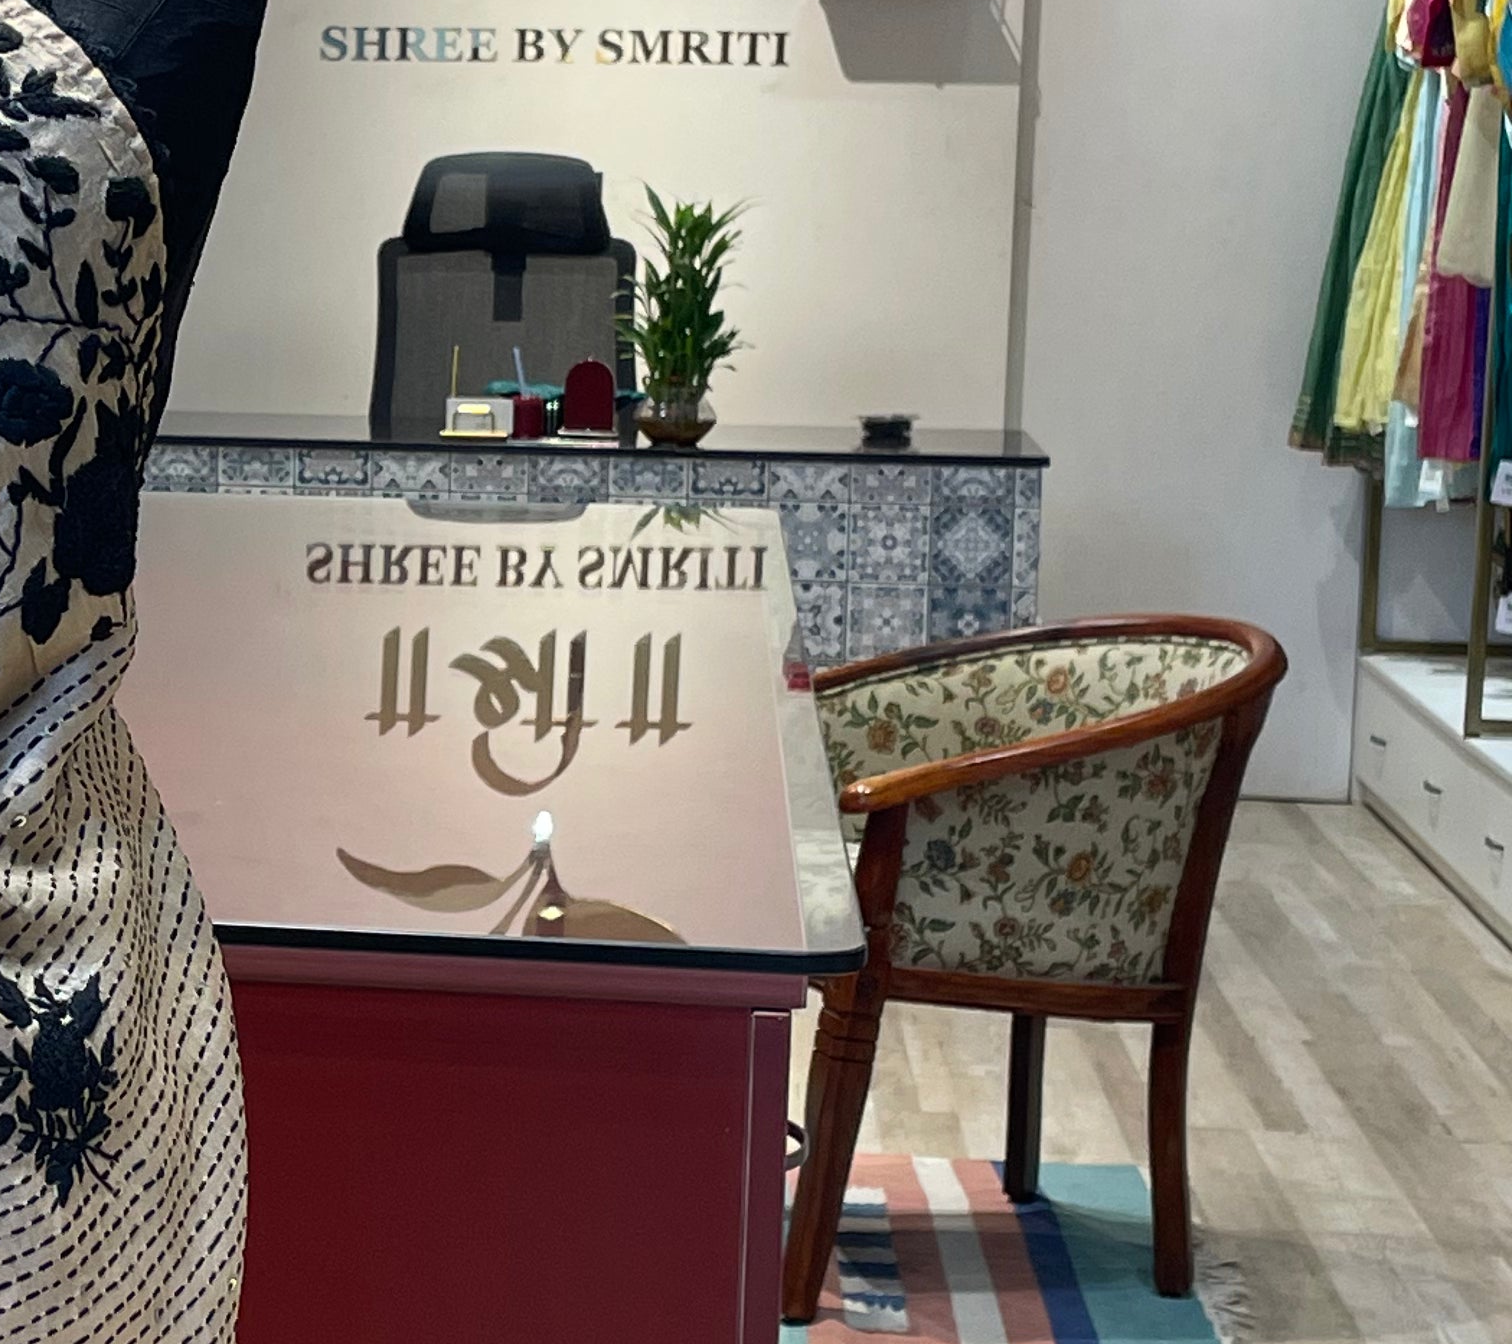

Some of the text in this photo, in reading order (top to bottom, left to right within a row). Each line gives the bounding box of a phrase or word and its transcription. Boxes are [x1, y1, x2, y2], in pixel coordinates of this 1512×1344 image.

[319, 25, 789, 67] SHREE BY SMRITI
